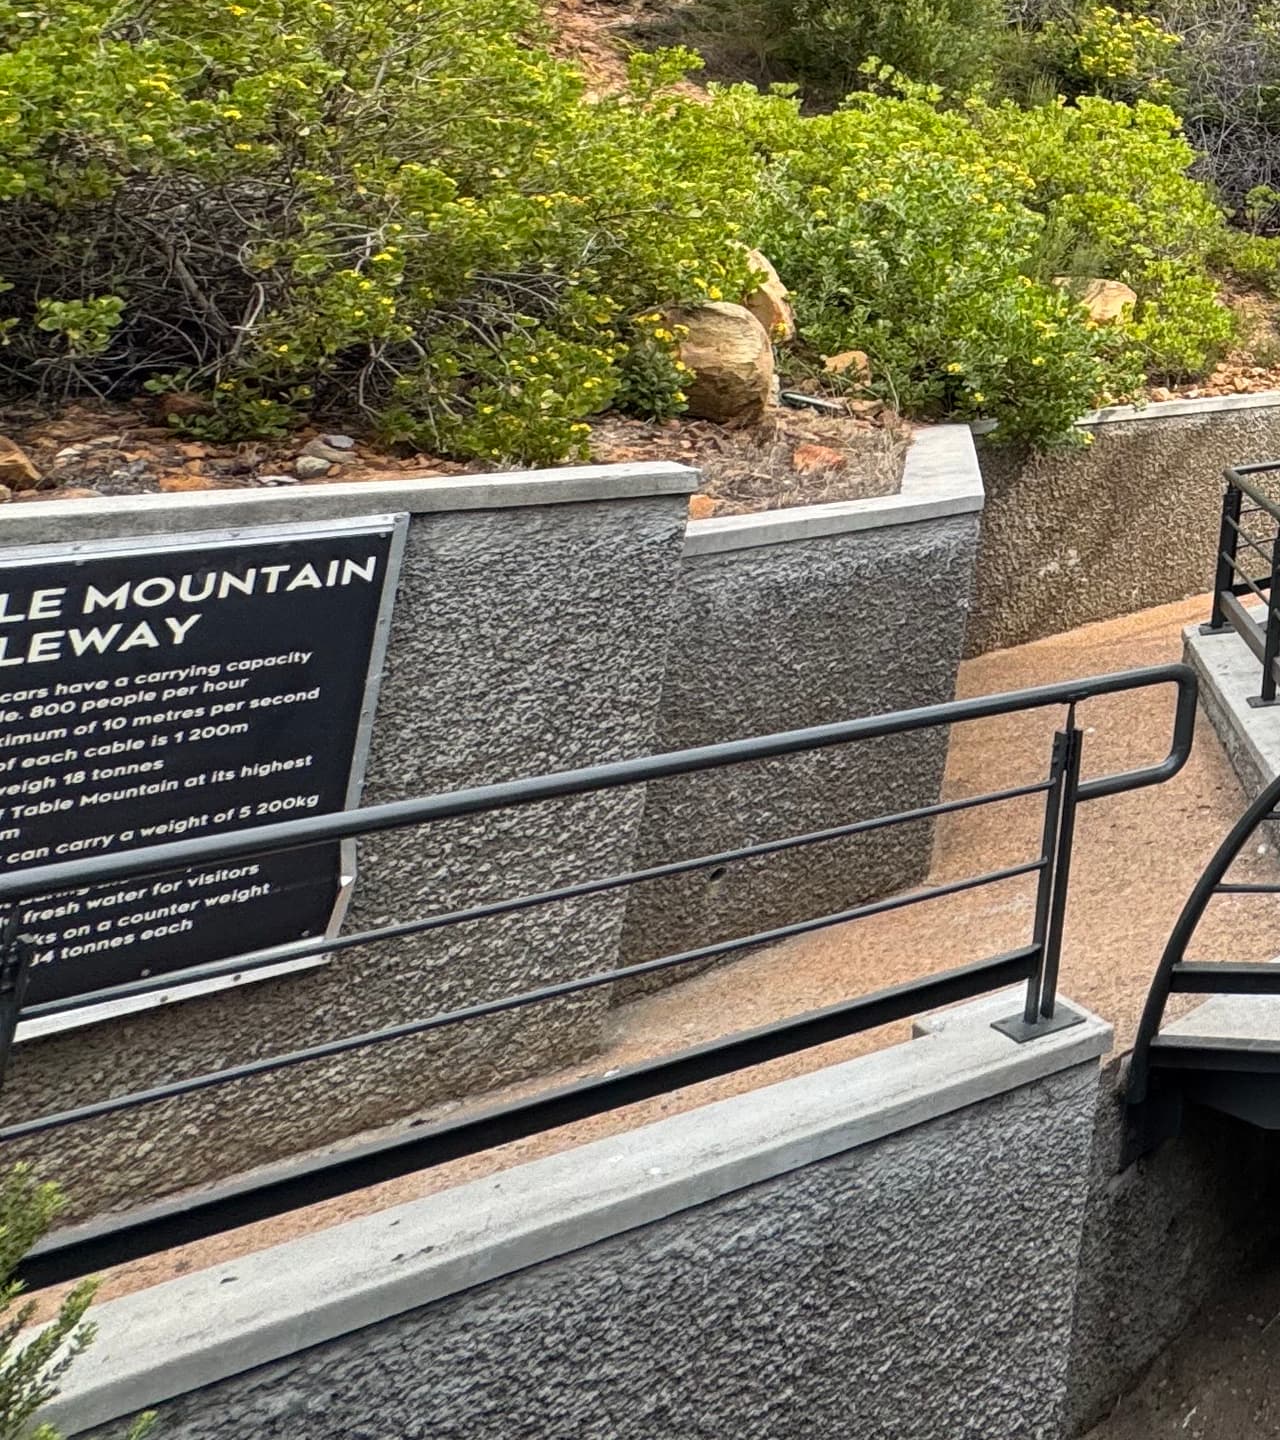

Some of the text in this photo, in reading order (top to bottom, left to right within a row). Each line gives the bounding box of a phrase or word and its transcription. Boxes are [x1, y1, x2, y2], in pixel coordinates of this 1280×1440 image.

[82, 556, 377, 614] MOUNTAIN
[0, 651, 314, 704] cars have a carrying capacity
[29, 700, 76, 719] 800
[81, 690, 157, 713] people
[162, 685, 199, 701] per
[203, 678, 249, 693] hour
[73, 720, 98, 736] of
[102, 717, 127, 732] 10
[132, 706, 206, 727] metres
[210, 700, 246, 717] per
[249, 687, 321, 709] second
[21, 749, 78, 768] each
[84, 739, 146, 758] cable
[151, 734, 169, 747] is
[174, 731, 184, 744] 1
[188, 723, 249, 741] 200m
[11, 799, 74, 819] Table
[79, 779, 178, 807] Mountain
[184, 773, 206, 788] at
[211, 770, 236, 783] its
[240, 755, 313, 778] highest
[63, 771, 86, 786] 18
[91, 760, 164, 781] tonnes
[6, 847, 49, 864] can
[55, 834, 115, 854] carry
[120, 830, 135, 841] a
[140, 812, 209, 838] weight
[213, 808, 235, 824] of
[239, 805, 252, 819] 5
[256, 793, 320, 816] 200kg
[23, 902, 80, 924] fresh
[86, 888, 148, 910] water
[152, 880, 183, 896] for
[187, 863, 260, 887] visitors
[63, 925, 90, 939] on
[97, 920, 112, 931] a
[118, 899, 200, 927] counter
[204, 883, 271, 907] weight
[61, 934, 135, 959] tonnes
[140, 920, 193, 940] each
